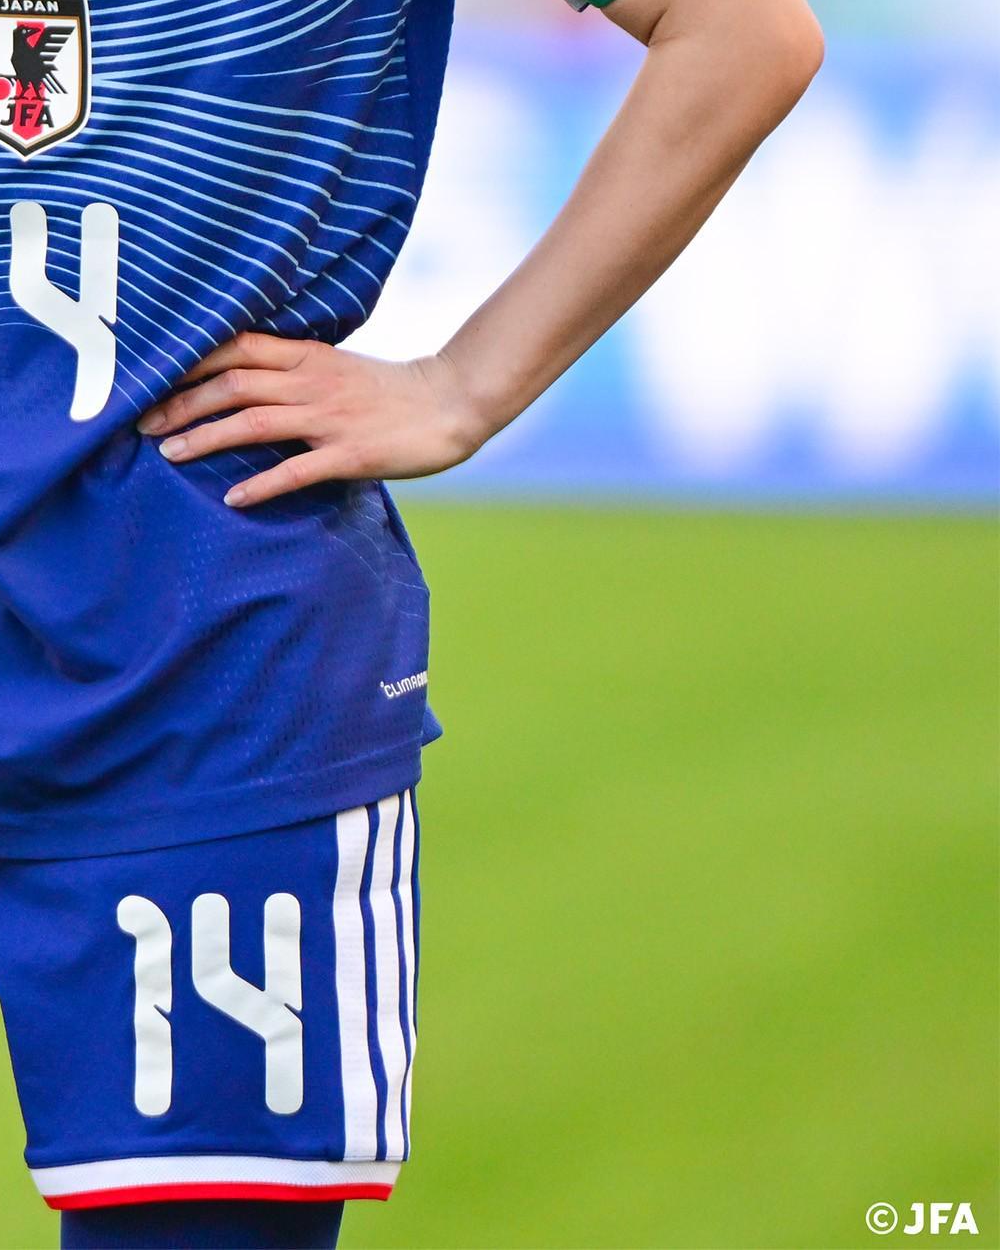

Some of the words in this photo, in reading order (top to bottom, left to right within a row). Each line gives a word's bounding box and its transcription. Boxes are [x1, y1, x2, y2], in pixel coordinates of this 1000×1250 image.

[1, 0, 59, 12] JAPAN
[0, 103, 54, 128] JFA
[117, 893, 304, 1117] 14
